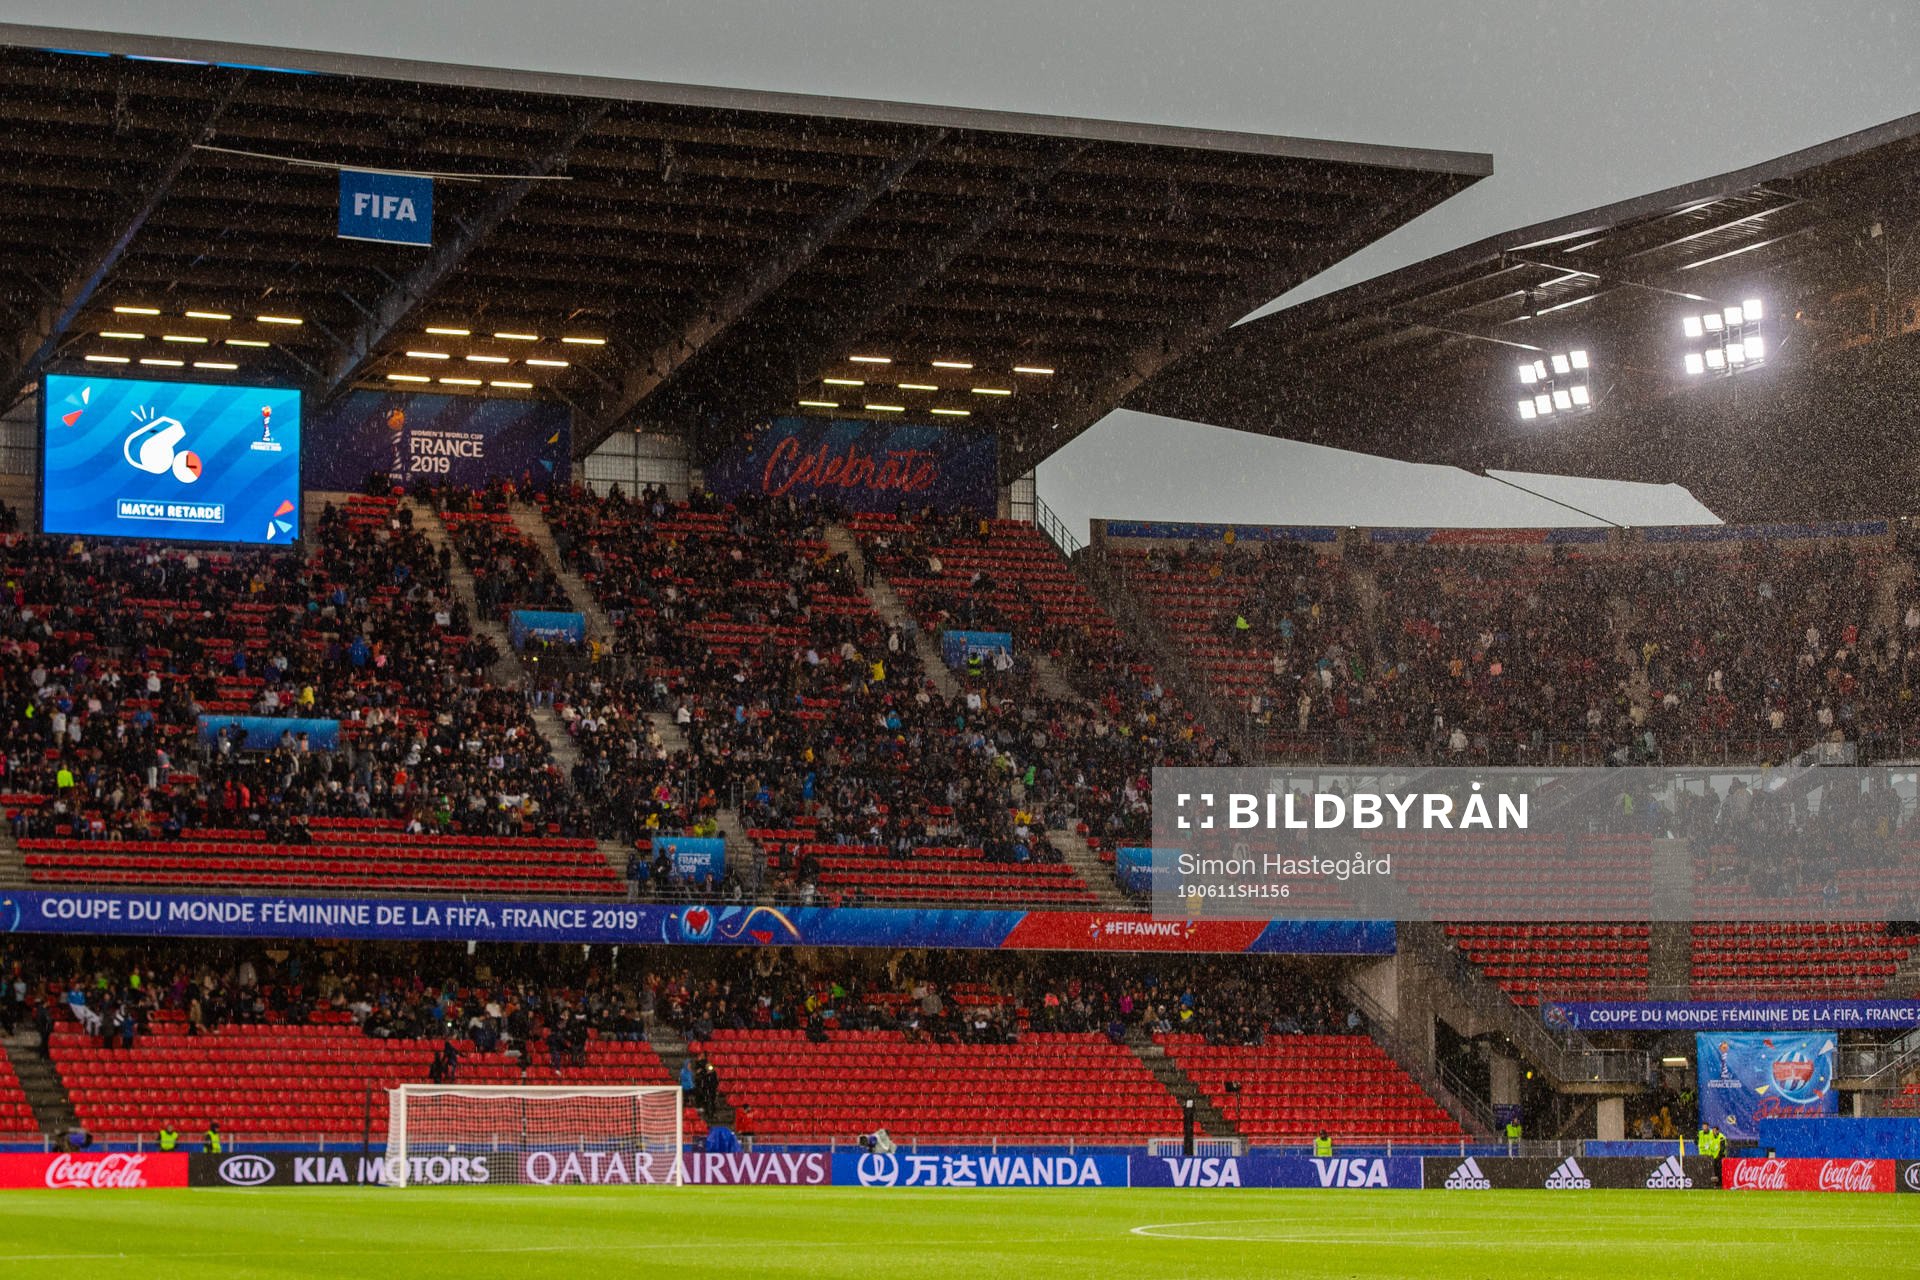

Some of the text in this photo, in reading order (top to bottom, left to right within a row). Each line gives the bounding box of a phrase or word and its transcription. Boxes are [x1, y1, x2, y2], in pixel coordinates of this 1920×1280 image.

[354, 192, 417, 222] FIFA
[410, 438, 485, 458] FRANCE
[410, 455, 450, 473] 2019
[761, 436, 940, 497] Celebrate
[121, 503, 221, 520] MATCH RETARDÉ
[41, 898, 121, 919] COUPE
[128, 901, 162, 920] DU
[169, 902, 255, 922] MONDE
[260, 900, 370, 925] FÉMININE
[376, 905, 405, 925] DE
[412, 906, 440, 925] LA
[446, 907, 496, 928] FIFA,
[502, 908, 586, 929] FRANCE
[1105, 921, 1181, 936] #FIFAWWC
[1590, 1010, 1637, 1022] COUPE
[1642, 1010, 1661, 1022] DU
[1666, 1009, 1718, 1022] MONDE
[1722, 1007, 1788, 1022] FÉMININE
[1792, 1009, 1810, 1021] DE
[1813, 1009, 1831, 1021] LA
[1834, 1008, 1863, 1022] FIFA,
[1866, 1007, 1914, 1020] FRANCE
[45, 1153, 147, 1188] Coca-Cola
[228, 1161, 266, 1180] KIA
[294, 1156, 490, 1183] KIA MOTORS
[526, 1151, 655, 1185] QATAR
[905, 1154, 977, 1186] 万达
[979, 1156, 1102, 1186] WANDA
[1163, 1158, 1241, 1187] VISA
[1309, 1158, 1388, 1187] VISA
[1445, 1176, 1490, 1189] adidas
[1545, 1176, 1591, 1189] adidas
[1646, 1175, 1693, 1189] adidas
[1732, 1159, 1790, 1190] Coca-Cola
[1818, 1159, 1877, 1191] Coca-Cola
